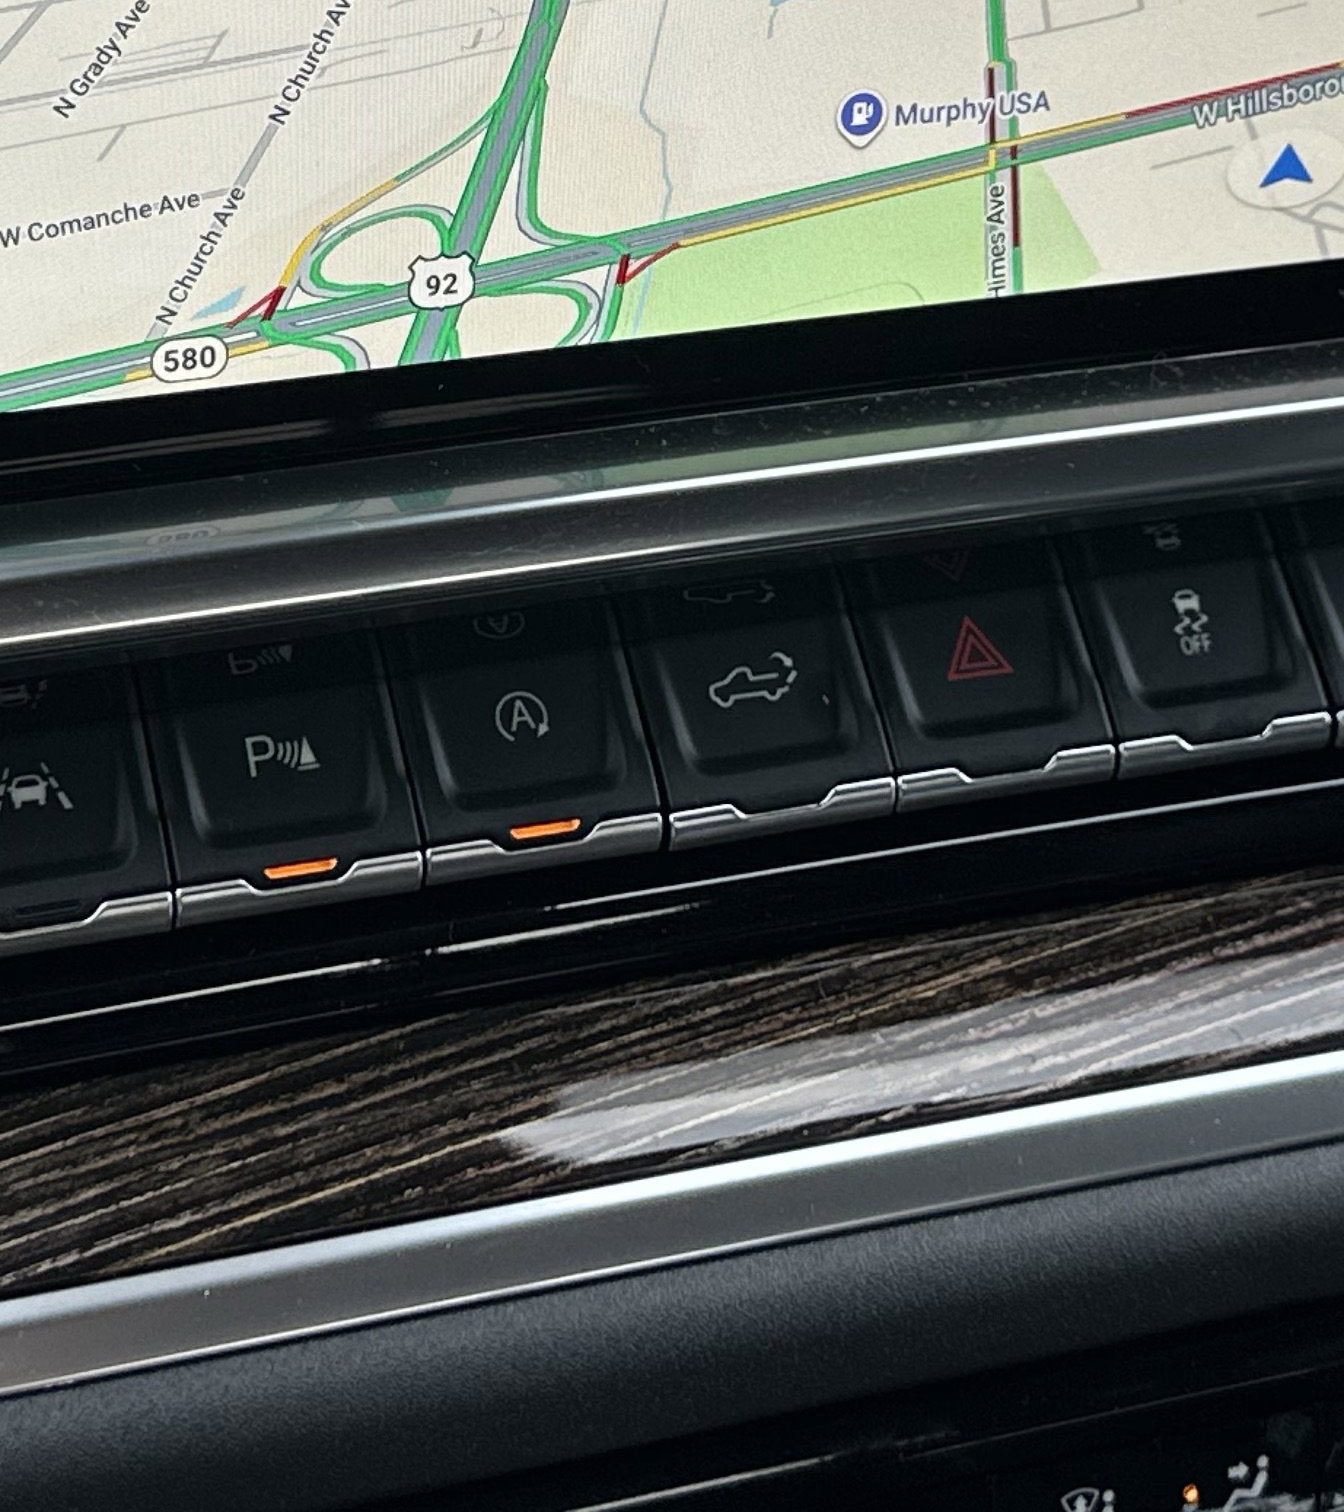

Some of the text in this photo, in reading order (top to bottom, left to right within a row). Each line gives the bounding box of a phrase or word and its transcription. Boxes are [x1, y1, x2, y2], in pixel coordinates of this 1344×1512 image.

[53, 0, 149, 118] N Grady Ave
[269, 105, 291, 125] N
[282, 29, 333, 104] Church
[895, 91, 1050, 126] Murphy USA
[1194, 102, 1219, 129] W
[28, 203, 152, 242] Comanche
[158, 191, 200, 216] Ave
[987, 185, 1005, 225] Ave
[156, 187, 245, 325] N Church Ave
[426, 274, 458, 295] 92
[163, 346, 216, 372] 580
[1180, 632, 1211, 655] OFF
